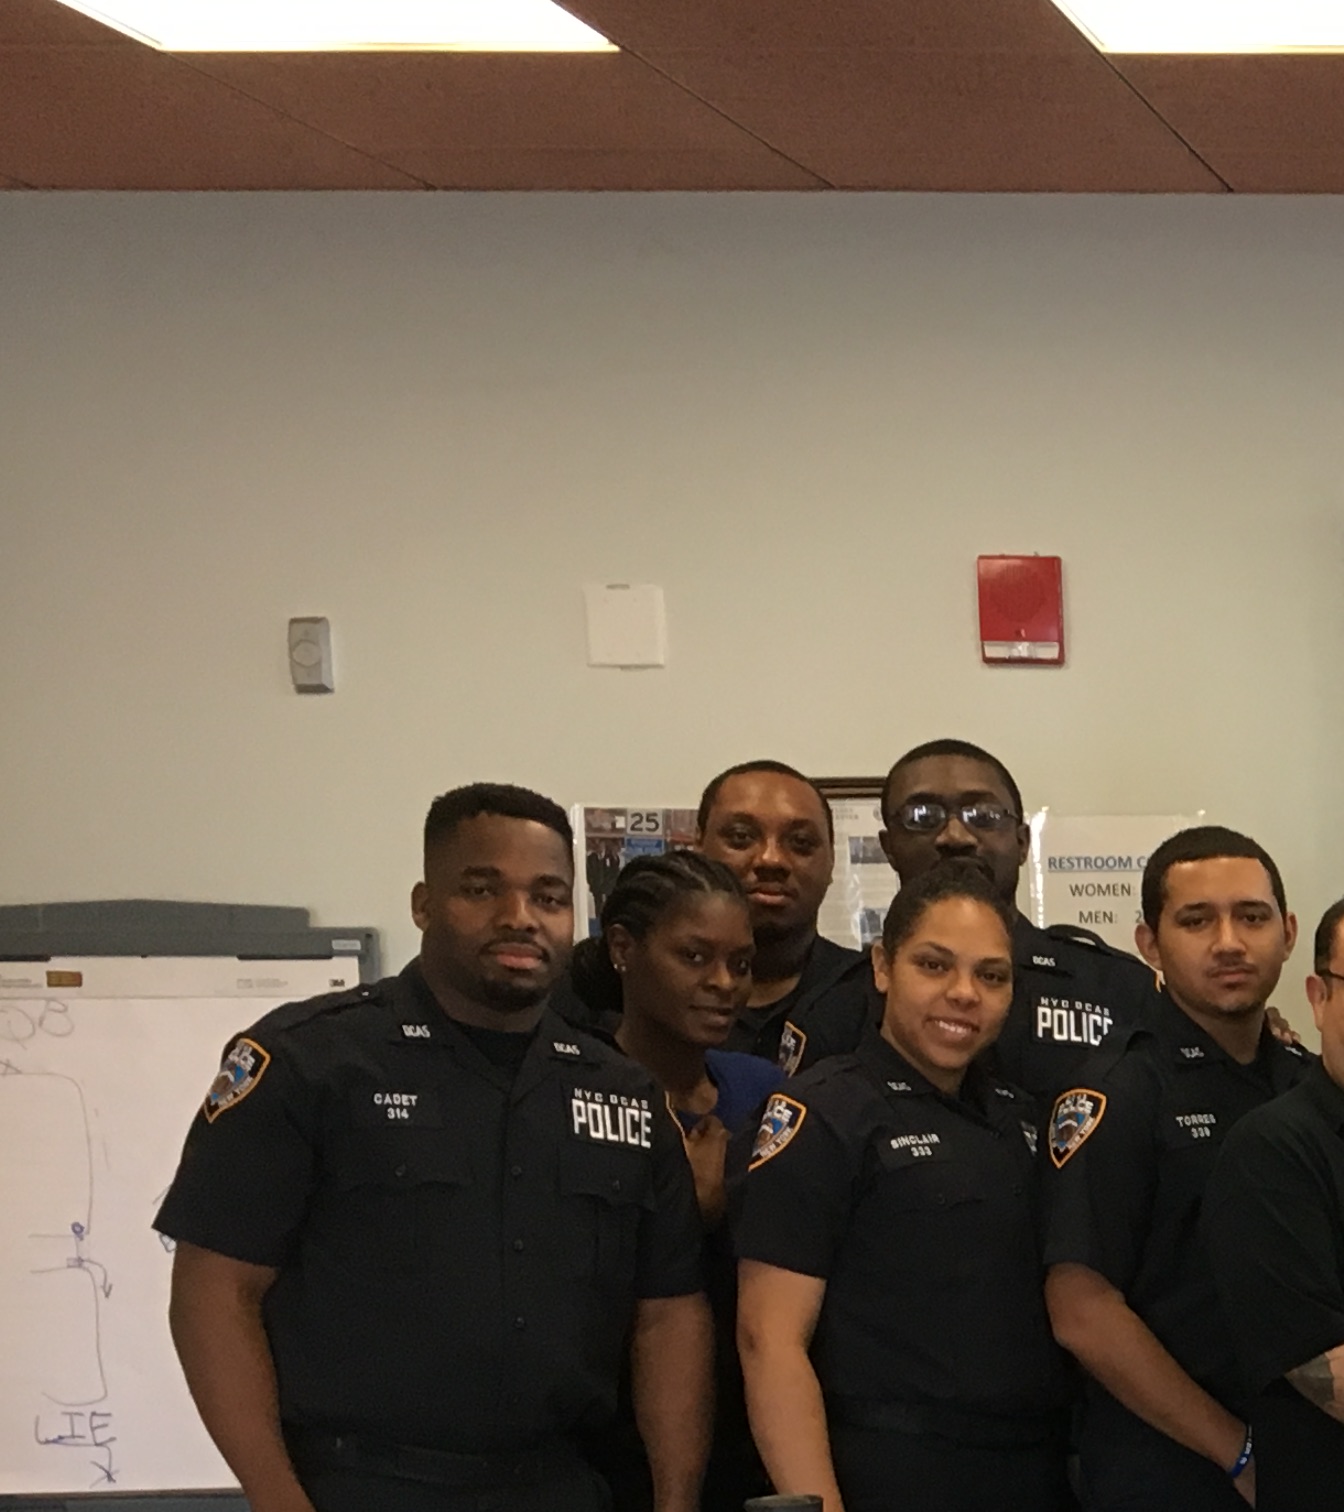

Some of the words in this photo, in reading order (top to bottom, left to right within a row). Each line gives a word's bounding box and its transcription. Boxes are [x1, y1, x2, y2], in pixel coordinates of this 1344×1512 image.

[629, 811, 660, 833] 25
[1047, 855, 1133, 872] RESTROOM
[1040, 995, 1070, 1009] NYC
[1074, 1002, 1111, 1018] DCAS
[373, 1092, 418, 1107] CADET
[573, 1087, 604, 1103] NYC
[609, 1094, 649, 1110] DCAS
[387, 1107, 410, 1119] 314
[1175, 1113, 1217, 1128] TORRES
[571, 1098, 652, 1150] POLICE
[890, 1132, 941, 1150] SINCLAIR
